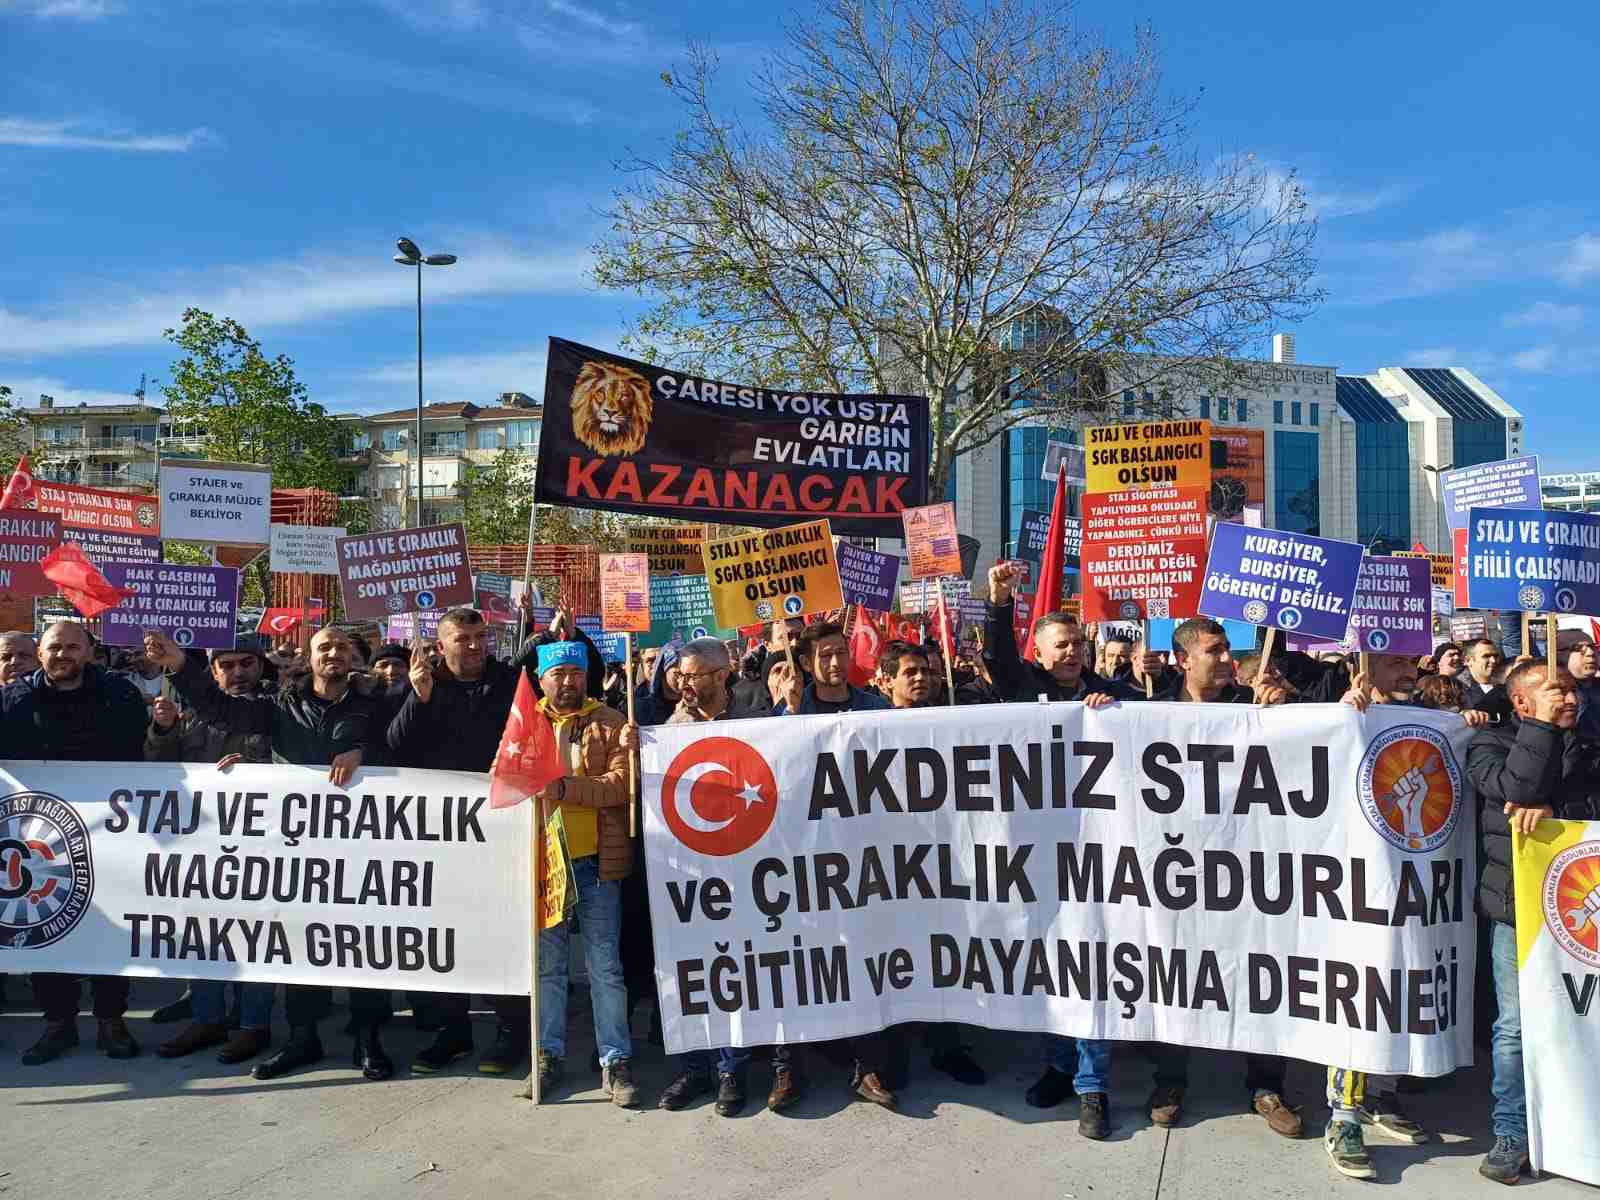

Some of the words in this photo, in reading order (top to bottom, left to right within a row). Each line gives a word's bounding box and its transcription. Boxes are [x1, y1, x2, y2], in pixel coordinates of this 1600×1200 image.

[656, 375, 764, 411] ÇARESİ
[770, 393, 832, 417] YOK
[837, 401, 910, 425] USTA
[800, 418, 910, 449] GARİBİN
[1091, 426, 1120, 443] STAJ
[1123, 425, 1139, 440] VE
[1143, 421, 1203, 444] ÇIRAKLIK
[752, 438, 910, 473] EVLATLARI
[1092, 449, 1120, 465] SGK
[1121, 443, 1203, 468] BAŞLANGICI
[189, 477, 228, 489] STAJER
[230, 481, 244, 490] ve
[566, 456, 911, 514] KAZANACAK
[1118, 465, 1177, 484] OLSUN
[40, 487, 66, 501] STAJ
[68, 491, 113, 508] ÇIRAKLIK
[115, 497, 133, 511] SGK
[169, 492, 223, 504] ÇIRAKLAR
[225, 493, 264, 506] MÜJDE
[1108, 493, 1129, 502] STAJ
[1150, 500, 1197, 512] OKULDAKİ
[103, 513, 133, 528] OLSUN
[190, 507, 242, 520] BEKLİYOR
[64, 529, 86, 540] STAJ
[88, 533, 100, 542] VE
[103, 535, 143, 546] ÇIRAKLIK
[343, 541, 376, 560] STAJ
[377, 537, 395, 555] VE
[398, 528, 460, 557] ÇIRAKLIK
[710, 543, 740, 561] STAJ
[742, 536, 760, 555] VE
[762, 525, 824, 556] ÇIRAKLIK
[1476, 519, 1514, 544] STAJ
[1518, 520, 1540, 544] VE
[1108, 541, 1175, 558] DERDİMİZ
[1244, 535, 1329, 567] KURSİYER,
[347, 552, 463, 580] MAĞDURİYETİNE
[714, 566, 745, 585] SGK
[744, 548, 828, 580] BAŞLANGICI
[1087, 556, 1156, 573] EMEKLİLİK
[1159, 553, 1198, 570] DEĞİL
[1239, 558, 1323, 589] BURSİYER,
[1473, 549, 1512, 579] FİİLİ
[126, 568, 154, 580] HAK
[158, 570, 216, 584] GASBINA
[358, 580, 387, 599] SON
[390, 571, 457, 594] VERİLSİN!
[744, 574, 806, 600] OLSUN
[1093, 570, 1193, 588] HAKLARIMIZIN
[155, 583, 217, 597] VERİLSİN!
[1108, 584, 1179, 600] İADESİDİR.
[1207, 571, 1276, 602] ÖĞRENCİ
[1279, 585, 1347, 615] DEĞİLİZ.
[138, 597, 152, 610] VE
[155, 598, 206, 613] ÇIRAKLIK
[208, 600, 230, 613] SGK
[1403, 597, 1425, 613] SGK
[110, 612, 184, 627] BAŞLANGICI
[188, 616, 228, 629] OLSUN
[1382, 616, 1424, 631] OLSUN
[807, 724, 1116, 821] AKDENİZ
[1140, 741, 1330, 819] STAJ
[105, 788, 203, 834] STAJ
[216, 791, 269, 836] VE
[280, 792, 487, 846] ÇIRAKLIK
[144, 845, 434, 907] MAĞDURLARI
[666, 876, 733, 923] ve
[752, 843, 1038, 932] ÇIRAKLIK
[1056, 832, 1463, 928] MAĞDURLARI
[124, 912, 293, 964] TRAKYA
[305, 922, 457, 973] GRUBU
[676, 935, 851, 1016] EĞİTİM
[864, 947, 915, 997] ve
[930, 933, 1230, 1020] DAYANIŞMA
[1248, 946, 1458, 1036] DERNEĞİ
